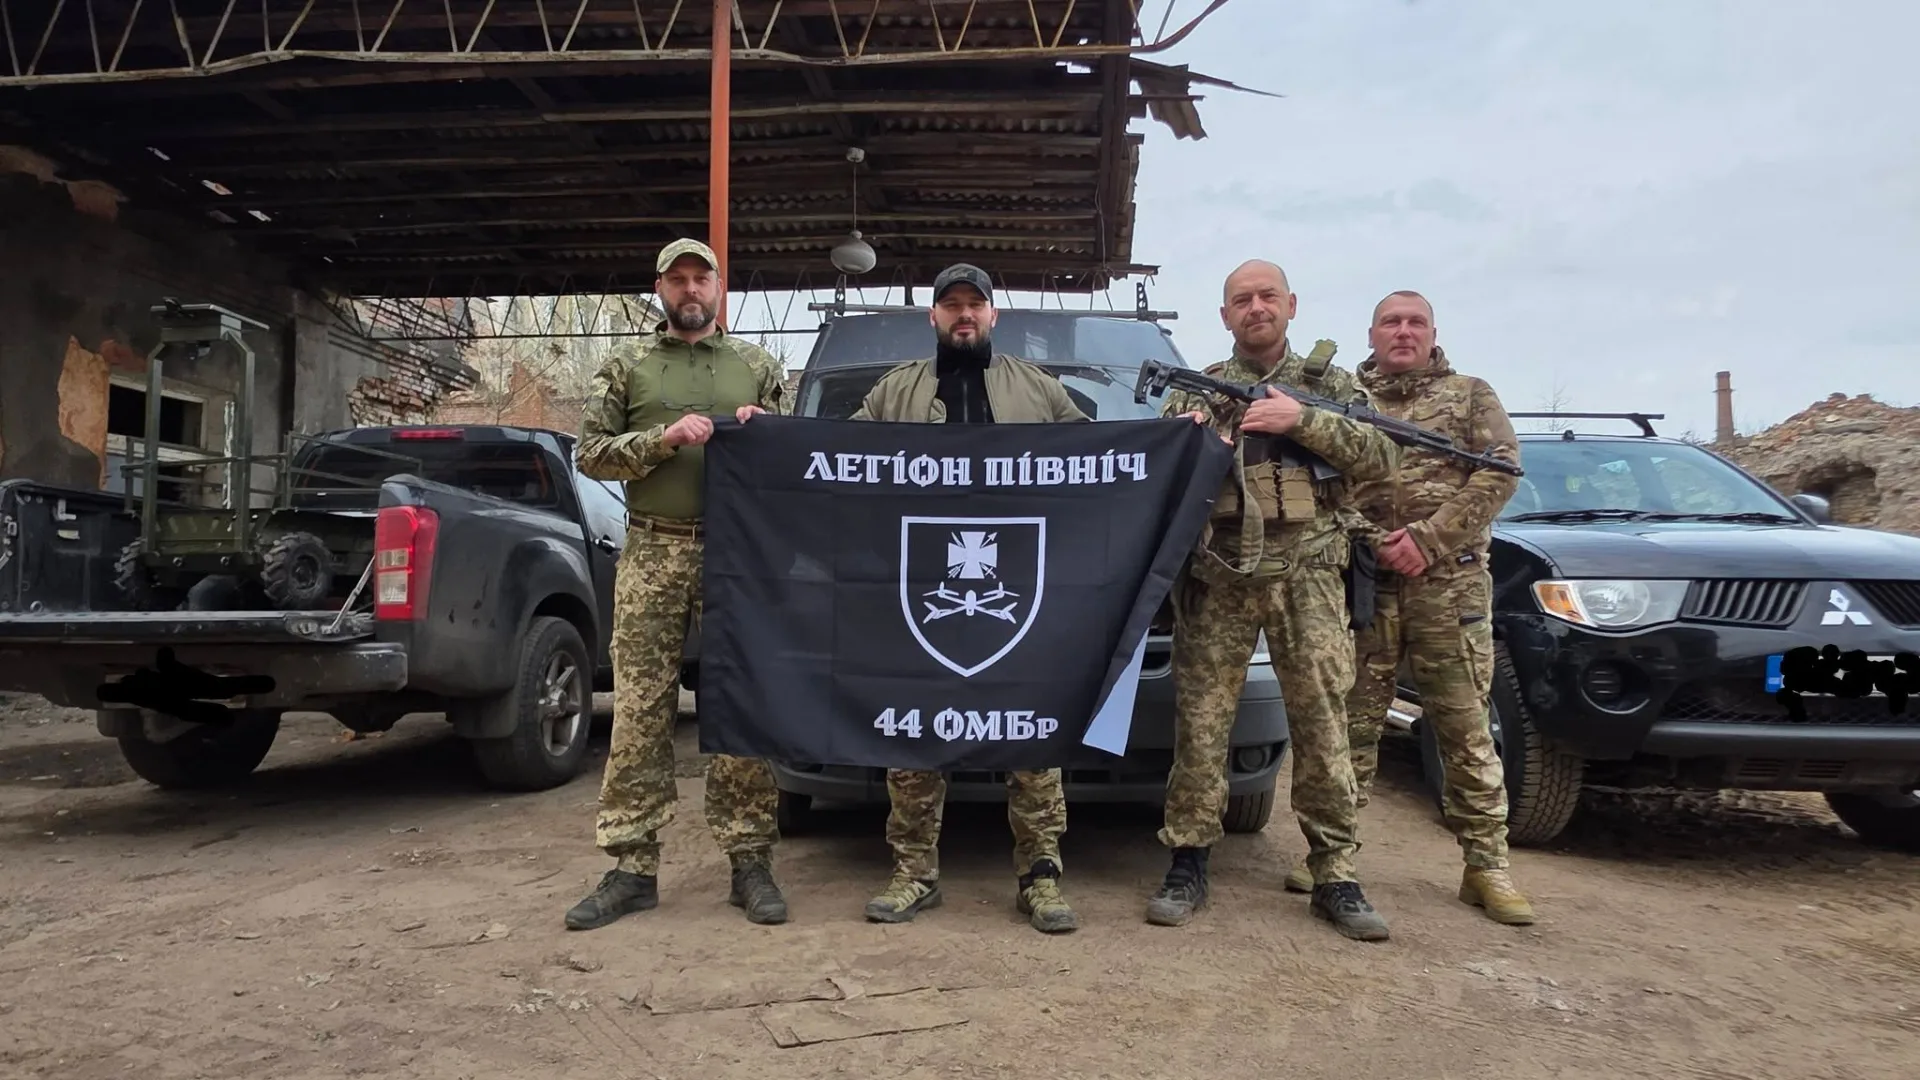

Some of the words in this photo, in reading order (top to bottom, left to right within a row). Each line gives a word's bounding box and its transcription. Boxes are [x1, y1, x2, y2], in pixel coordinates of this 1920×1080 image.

[804, 450, 973, 487] ЛЕГІОН
[983, 449, 1148, 486] ПІВНІЧ
[874, 707, 923, 738] 44
[934, 707, 1058, 742] ОМБр
